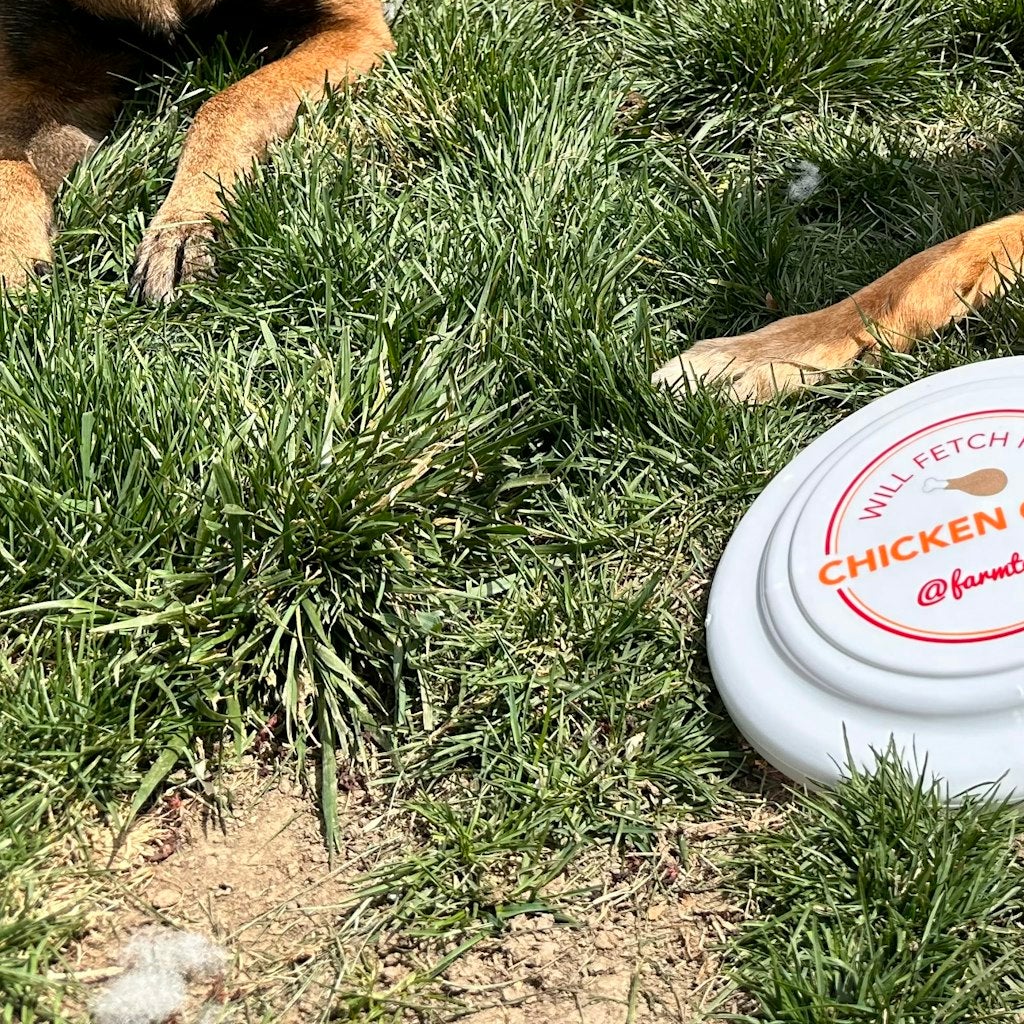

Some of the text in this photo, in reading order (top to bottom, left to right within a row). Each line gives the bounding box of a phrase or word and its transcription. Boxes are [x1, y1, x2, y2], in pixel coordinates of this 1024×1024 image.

[858, 472, 914, 521] WILL
[912, 431, 1009, 470] FETCH
[817, 506, 1008, 586] CHICKEN
